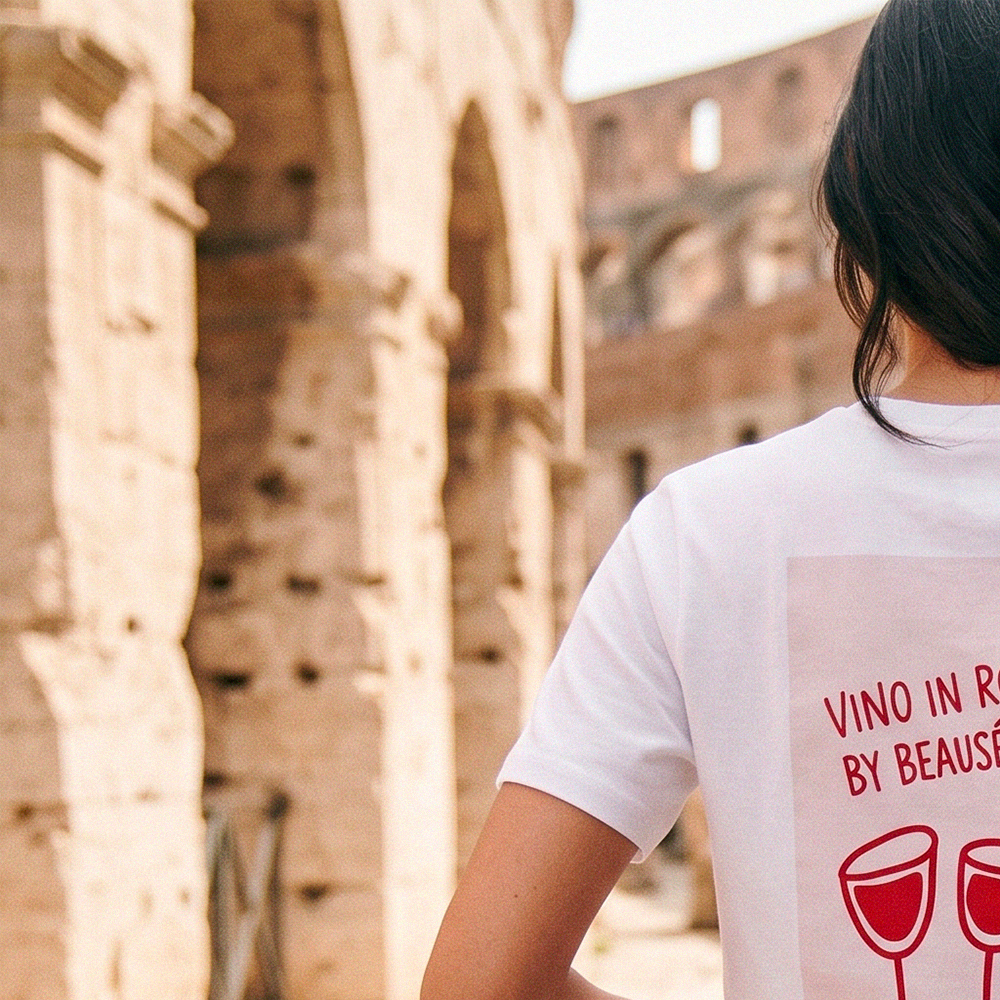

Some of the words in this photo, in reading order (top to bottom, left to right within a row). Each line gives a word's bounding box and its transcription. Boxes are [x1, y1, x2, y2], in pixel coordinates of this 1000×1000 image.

[824, 681, 912, 738] VINO
[925, 672, 962, 717] IN
[842, 750, 882, 797] BY
